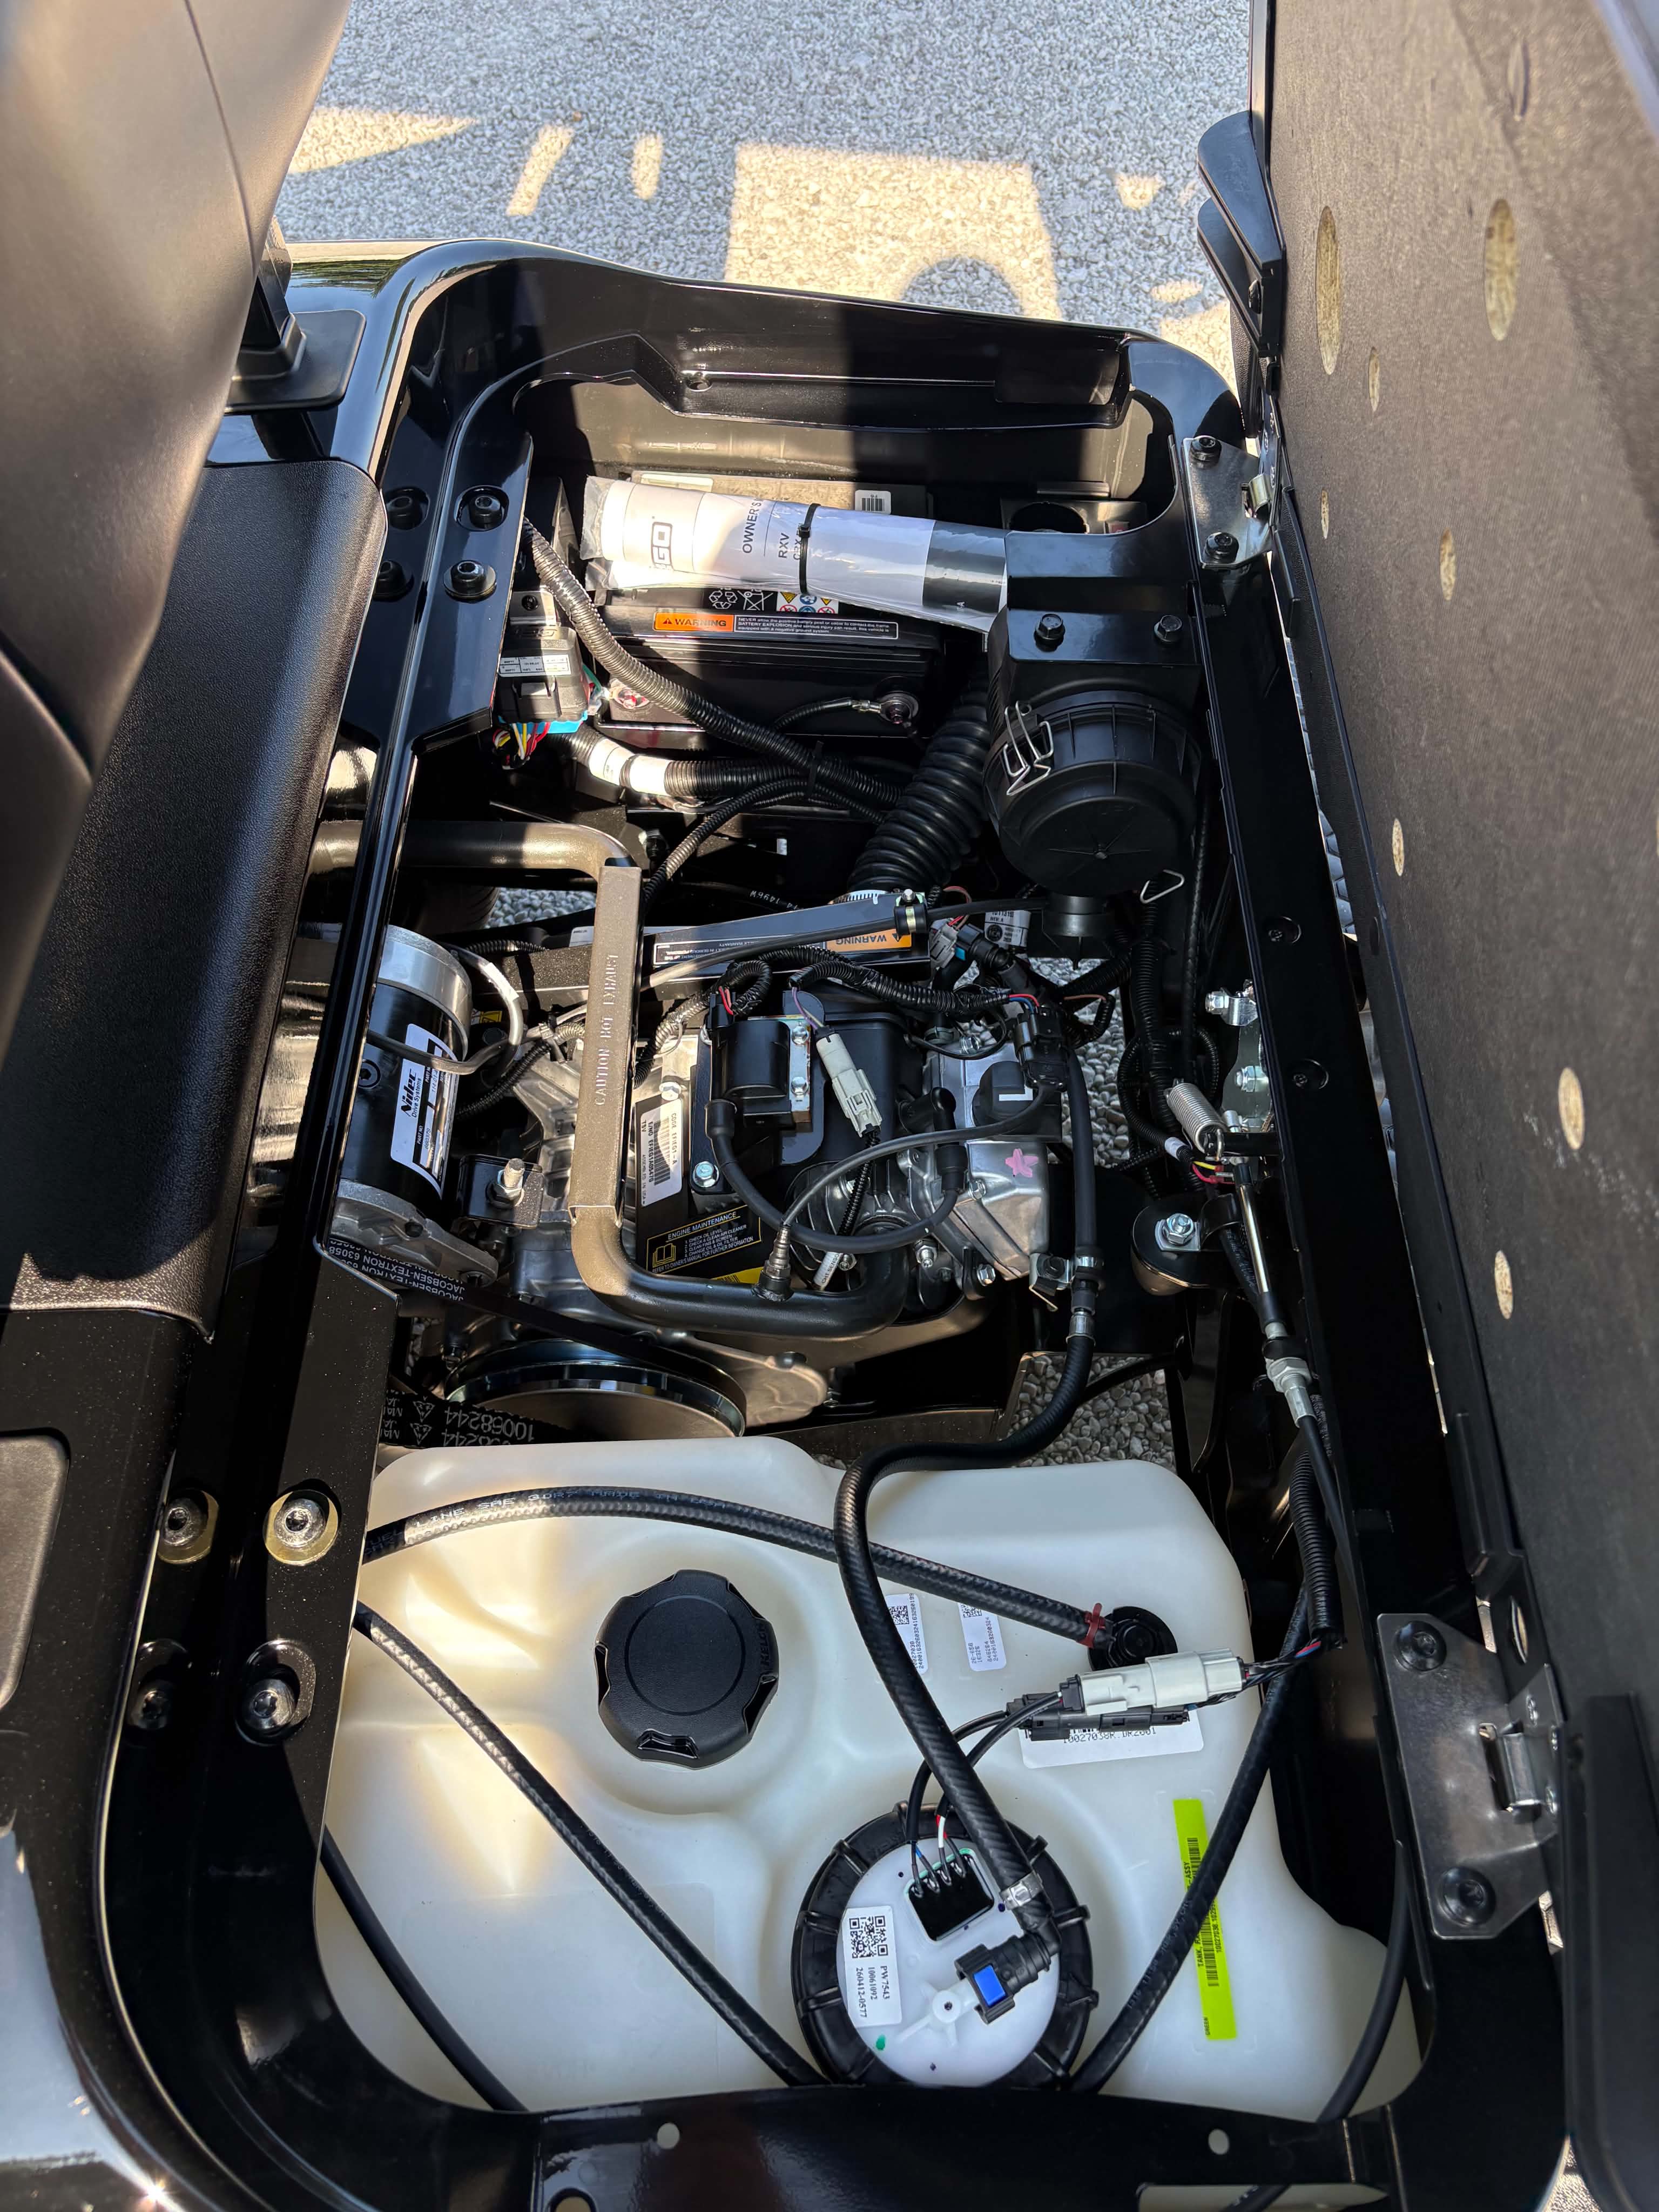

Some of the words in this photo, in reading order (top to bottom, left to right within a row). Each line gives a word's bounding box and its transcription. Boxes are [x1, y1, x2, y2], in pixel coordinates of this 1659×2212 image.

[742, 501, 761, 554] OWNER'S
[778, 532, 790, 558] RXV
[675, 618, 726, 627] WARNING
[835, 934, 887, 945] WARNING
[602, 955, 619, 1005] EXHAUST
[600, 1017, 614, 1038] HOT
[413, 1077, 422, 1102] Systems
[596, 1048, 610, 1106] CAUTION
[400, 1068, 416, 1117] Nidec
[667, 1227, 691, 1240] ENGINE
[692, 1211, 737, 1232] MAINTENANCE
[689, 1240, 703, 1248] CHECK
[727, 1224, 747, 1235] CLEANER
[689, 1235, 703, 1243] CHECK
[328, 1246, 360, 1260] 63058
[670, 1259, 687, 1269] OWNER'S
[686, 1254, 702, 1263] MANUAL
[702, 1251, 710, 1259] FOR
[710, 1245, 729, 1257] FURTHER
[728, 1236, 754, 1249] INFORMATION
[688, 1247, 706, 1257] CHANGE
[724, 1236, 738, 1245] FILTER
[689, 1244, 702, 1252] CLEAN
[715, 1235, 732, 1244] SCREEN
[362, 1254, 466, 1294] JACOBSEN-TEXTRON
[827, 1253, 840, 1273] SENSO
[443, 1406, 535, 1442] 10068244
[416, 1507, 465, 1528] LINE
[477, 1498, 515, 1510] SAE
[527, 1489, 579, 1501] 30R7
[591, 1489, 640, 1499] MADE
[656, 1493, 678, 1502] IN
[690, 1497, 727, 1509] USA
[909, 1641, 920, 1669] 0027038
[1196, 1946, 1205, 1968] TANK,
[856, 1967, 868, 2019] 260412-0577
[868, 1966, 878, 2001] 10061092
[880, 1965, 891, 2000] PW7543
